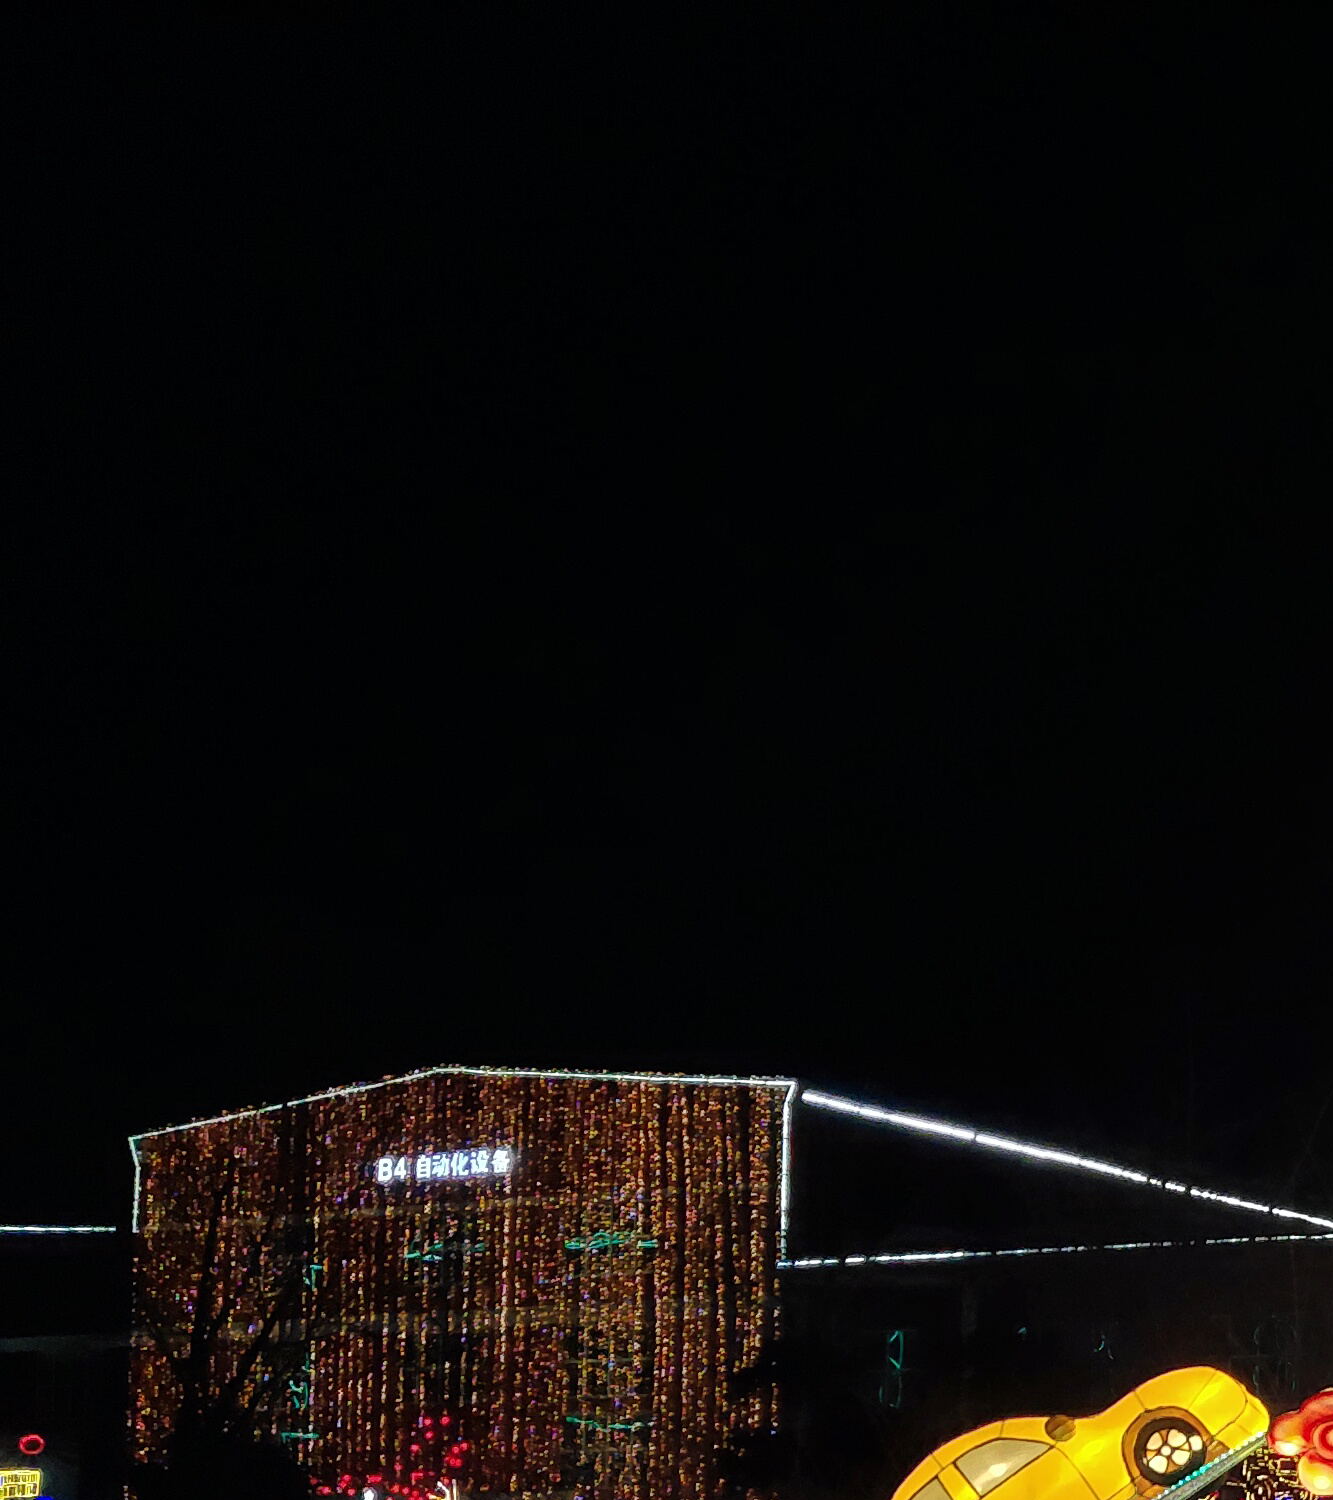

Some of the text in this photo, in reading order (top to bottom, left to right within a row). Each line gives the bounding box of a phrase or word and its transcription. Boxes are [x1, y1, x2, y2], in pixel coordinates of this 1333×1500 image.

[377, 1149, 511, 1183] B4 自动化设备
